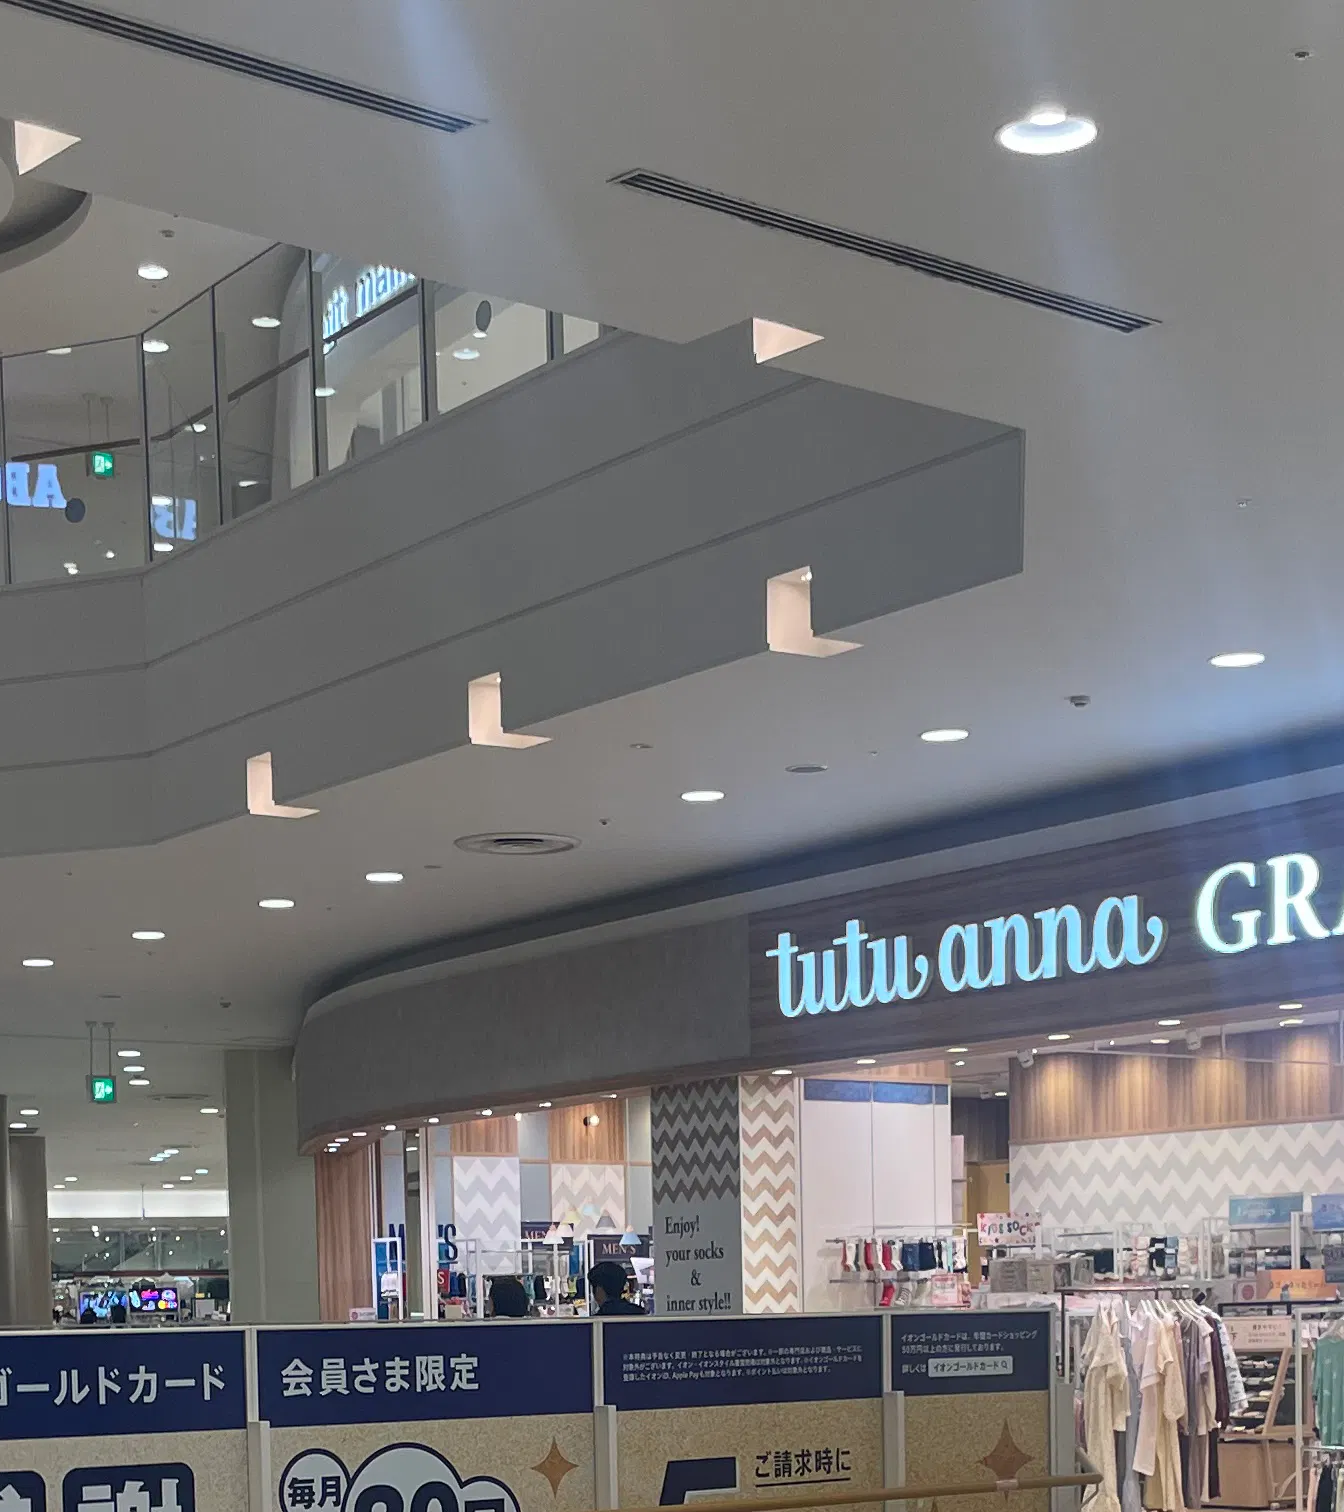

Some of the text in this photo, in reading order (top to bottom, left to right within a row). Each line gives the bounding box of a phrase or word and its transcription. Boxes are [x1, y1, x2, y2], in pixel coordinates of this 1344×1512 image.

[665, 1215, 700, 1239] Enjoy!
[1006, 1220, 1041, 1237] SOCK
[665, 1240, 724, 1268] your socks
[690, 1269, 701, 1286] &
[666, 1295, 696, 1312] inner
[281, 1353, 480, 1397] 会員さま限定
[756, 1447, 852, 1479] ご請求時に
